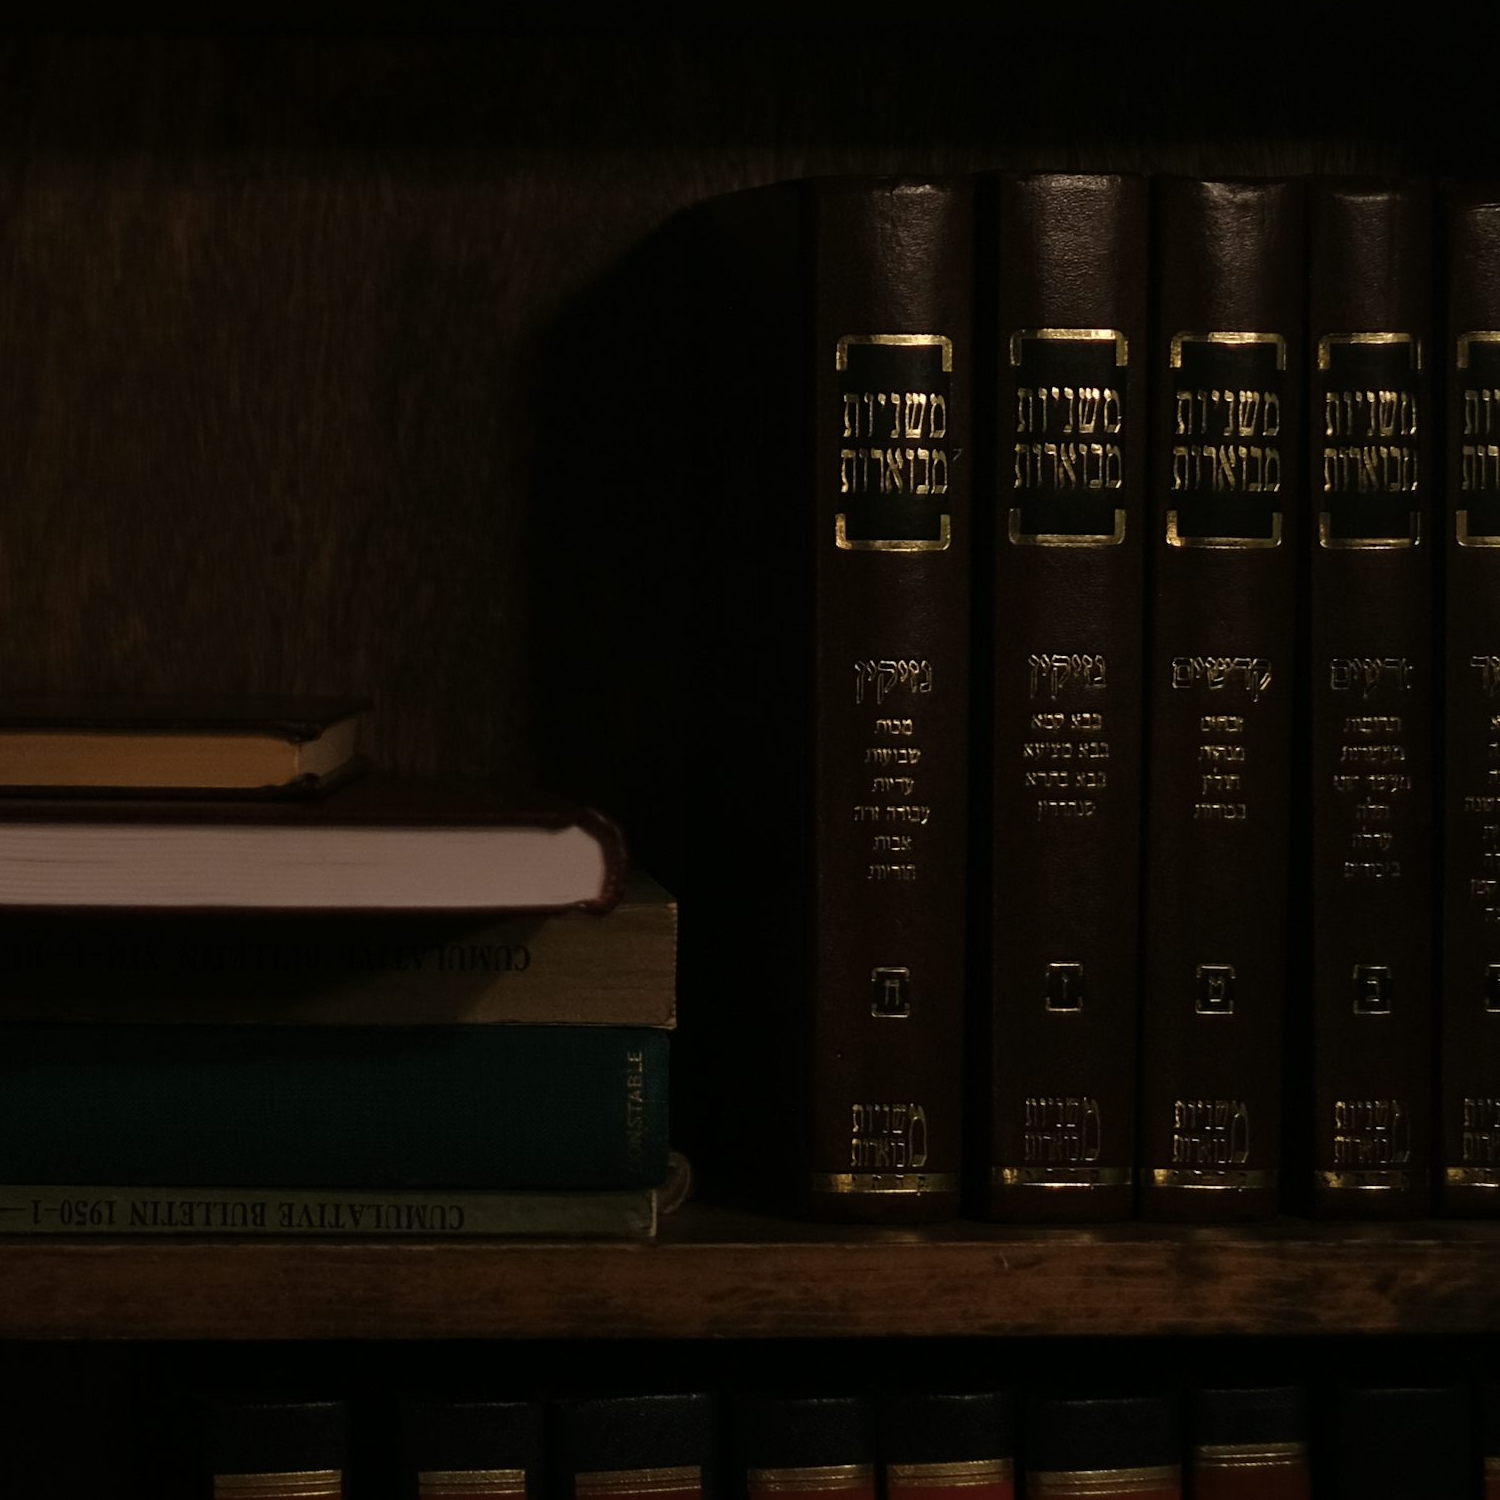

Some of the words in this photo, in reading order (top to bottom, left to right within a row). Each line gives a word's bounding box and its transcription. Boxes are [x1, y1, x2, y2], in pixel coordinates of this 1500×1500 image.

[841, 391, 948, 439] משניות
[1016, 386, 1122, 434] משניות
[1175, 389, 1281, 437] משניות
[1324, 390, 1418, 437] משניות
[839, 447, 949, 495] מבוארות
[1013, 442, 1123, 489] מבוארות
[1170, 445, 1282, 493] מבוארות
[1322, 447, 1419, 494] מבוארות
[853, 658, 933, 706] נזיקין
[1027, 652, 1107, 703] נזיקין
[1170, 655, 1273, 702] קדשים
[873, 717, 914, 737] מכות
[1030, 712, 1067, 734] קמא
[1070, 711, 1103, 731] בבא
[863, 746, 921, 766] שבועות
[1022, 740, 1073, 760] מציעא
[1077, 740, 1111, 759] בבא
[1024, 770, 1070, 788] בתרא
[1075, 770, 1107, 788] בבא
[852, 804, 882, 823] זרה
[886, 804, 932, 826] עבודה
[872, 834, 913, 853] אבות
[344, 944, 532, 973] CUMULATIVE
[129, 1200, 268, 1228] BULLETIN
[278, 1202, 465, 1230] CUMULATIVE
